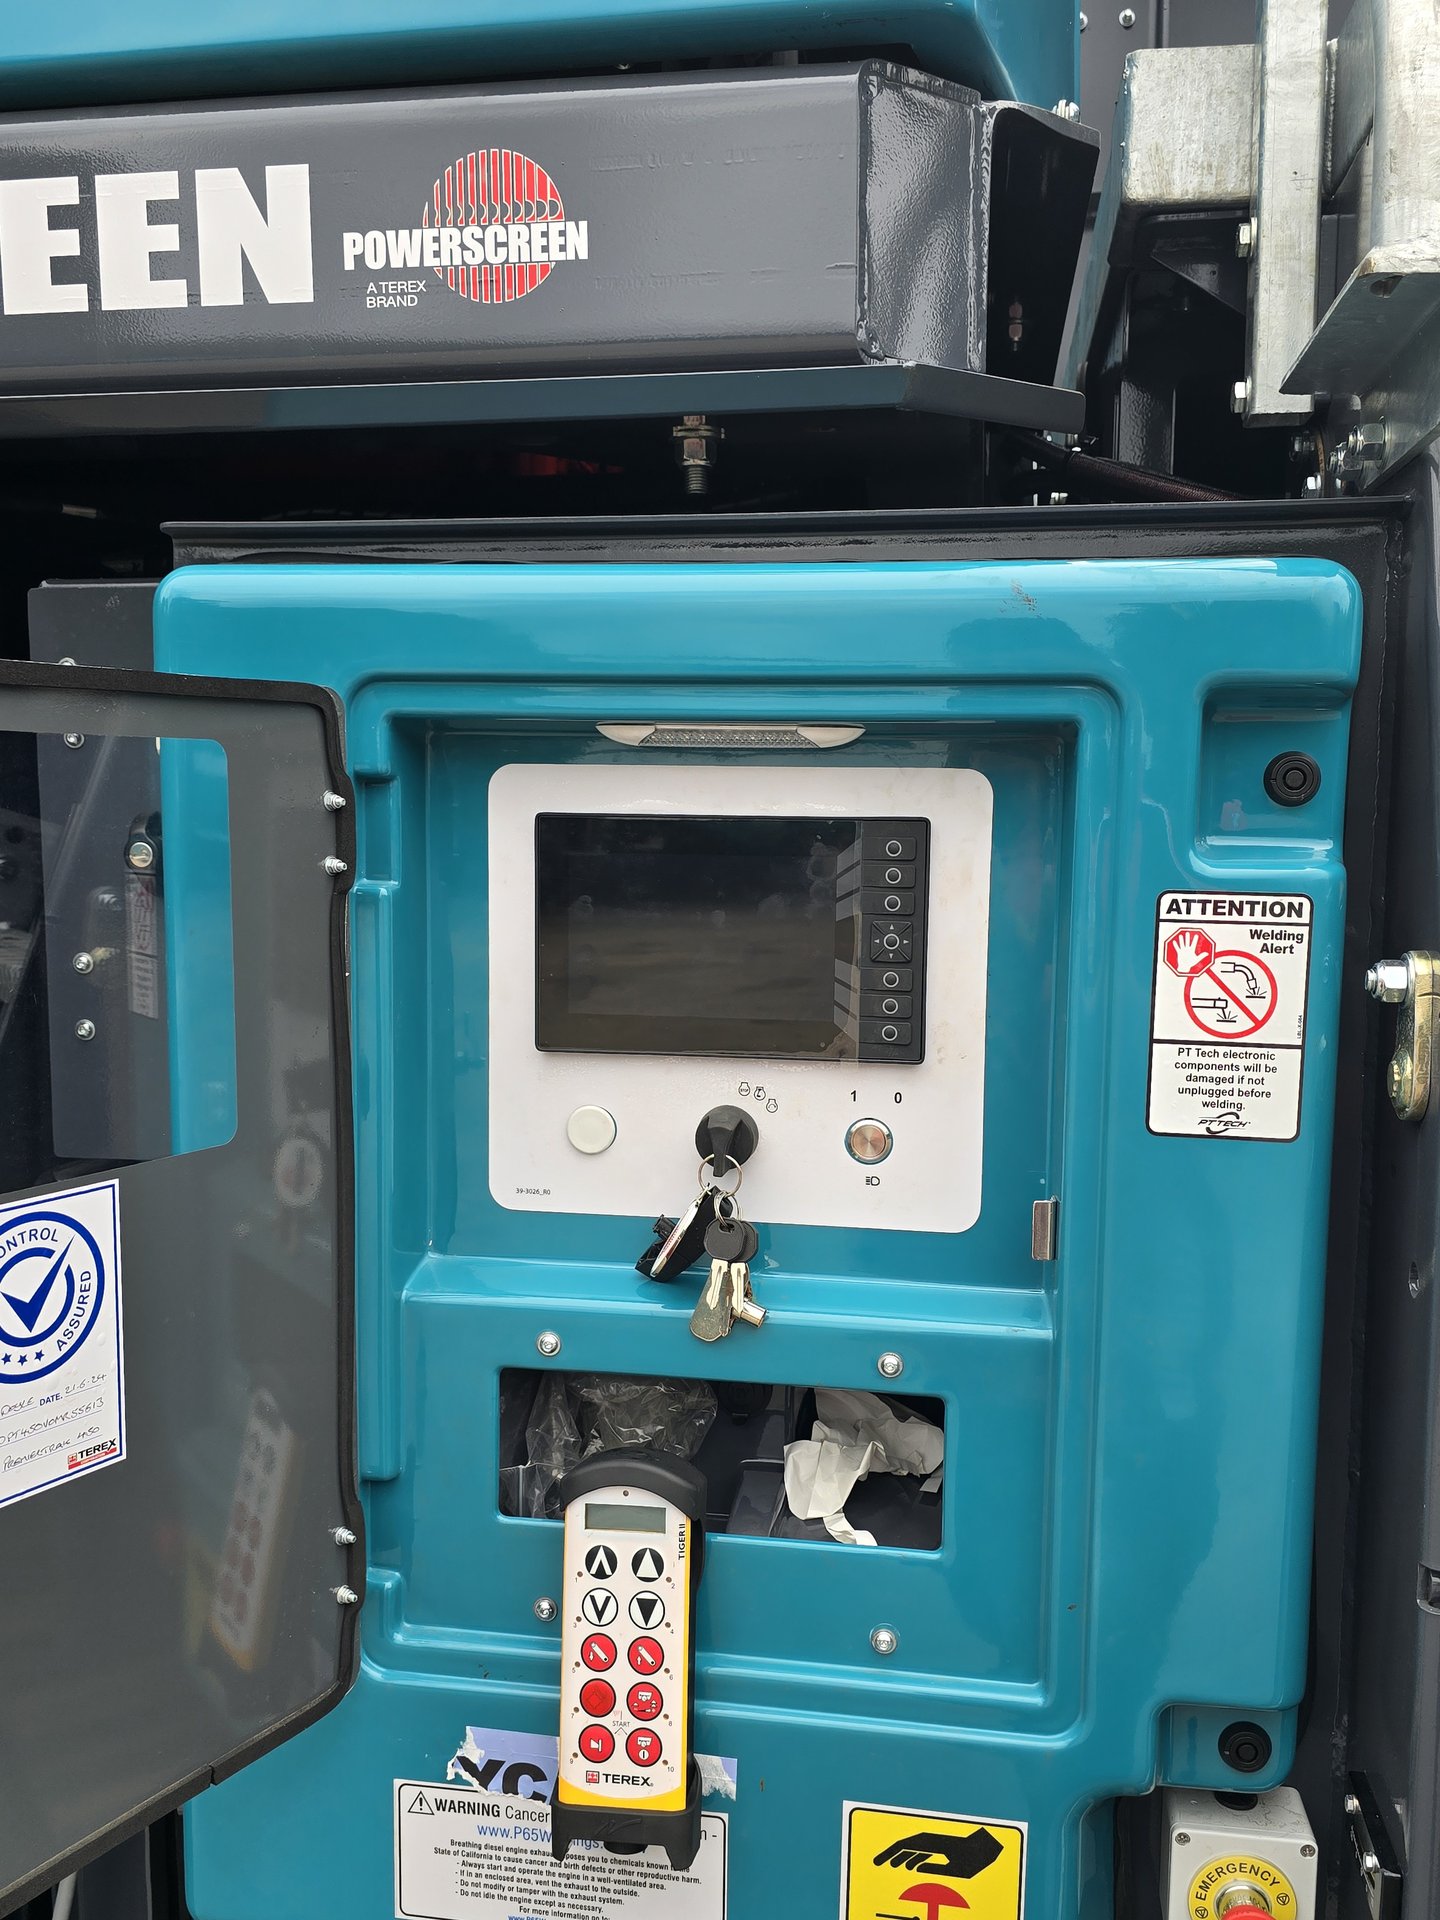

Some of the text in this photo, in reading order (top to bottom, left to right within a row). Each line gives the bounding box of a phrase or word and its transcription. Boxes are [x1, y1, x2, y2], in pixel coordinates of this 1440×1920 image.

[343, 220, 589, 271] POWERSCREEN
[366, 280, 426, 295] A TEREX
[366, 294, 418, 308] BRAND
[1166, 898, 1304, 918] ATTENTION
[1249, 928, 1304, 944] Welding
[1260, 942, 1294, 955] Alert
[1177, 1048, 1276, 1061] PT Tech electronic
[1174, 1061, 1278, 1074] components will be
[1185, 1073, 1265, 1087] damaged if not
[850, 1090, 857, 1102] 1
[894, 1092, 902, 1104] 0
[1177, 1086, 1272, 1099] unplugged before
[1201, 1099, 1246, 1112] welding.
[56, 1270, 92, 1352] ASSURED
[40, 1392, 63, 1406] DATE.
[78, 1438, 118, 1459] TEREX
[603, 1773, 652, 1786] TEREX
[434, 1798, 500, 1818] WARNING
[505, 1805, 550, 1823] Cancer
[450, 1839, 482, 1851] Breathing
[484, 1843, 504, 1852] diesel
[505, 1846, 528, 1855] engine
[587, 1856, 600, 1864] you
[610, 1858, 644, 1868] chemicals
[646, 1862, 669, 1871] known
[434, 1847, 451, 1856] State
[461, 1850, 493, 1860] California
[564, 1862, 579, 1870] birth
[581, 1864, 606, 1873] defects
[617, 1868, 635, 1877] other
[636, 1871, 680, 1882] reproductive
[681, 1875, 702, 1884] harm.
[461, 1861, 485, 1870] Always
[518, 1868, 544, 1877] operate
[558, 1872, 580, 1881] engine
[597, 1876, 647, 1888] well-ventilated
[1195, 1862, 1281, 1902] EMERGENCY
[460, 1879, 469, 1887] Do
[483, 1882, 506, 1892] modify
[516, 1886, 540, 1896] tamper
[542, 1889, 556, 1897] with
[570, 1893, 597, 1902] exhaust
[598, 1897, 624, 1905] system.
[484, 1873, 514, 1883] enclosed
[535, 1878, 550, 1886] vent
[564, 1882, 590, 1891] exhaust
[613, 1887, 640, 1897] outside.
[509, 1896, 532, 1905] engine
[534, 1899, 556, 1907] except
[567, 1903, 604, 1913] necessary.
[551, 1909, 590, 1920] information
